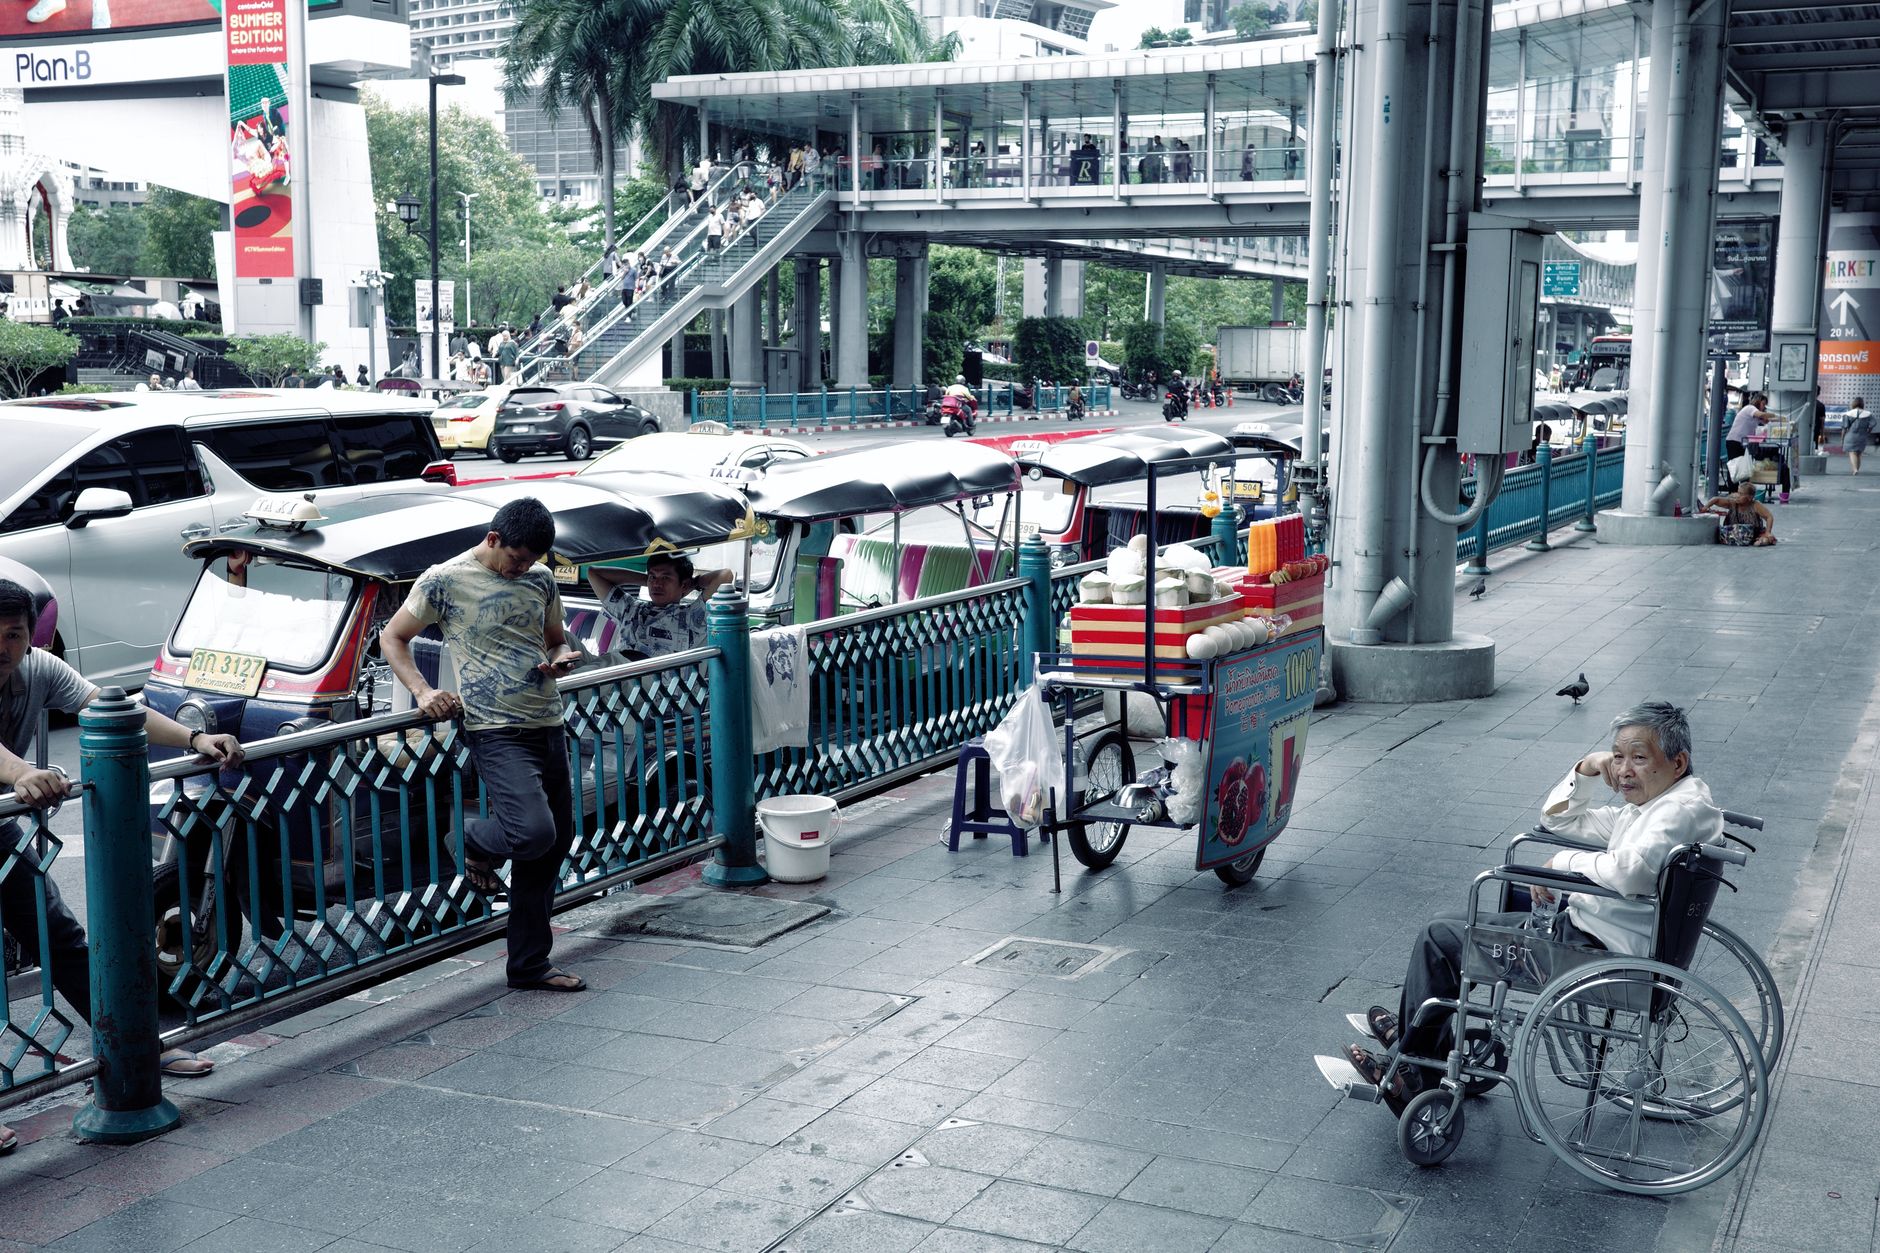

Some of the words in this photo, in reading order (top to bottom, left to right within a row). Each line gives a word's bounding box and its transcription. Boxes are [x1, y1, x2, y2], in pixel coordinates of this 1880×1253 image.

[230, 12, 283, 28] SUMMER
[230, 29, 284, 45] EDITION
[231, 46, 247, 54] where
[247, 45, 257, 53] the
[265, 45, 283, 53] begins
[1079, 160, 1092, 177] R
[1830, 328, 1842, 338] 20
[709, 467, 742, 480] TAXI
[256, 499, 299, 515] TAXI
[220, 655, 263, 678] 3127
[1284, 646, 1317, 702] 100%
[1492, 943, 1532, 962] BST
